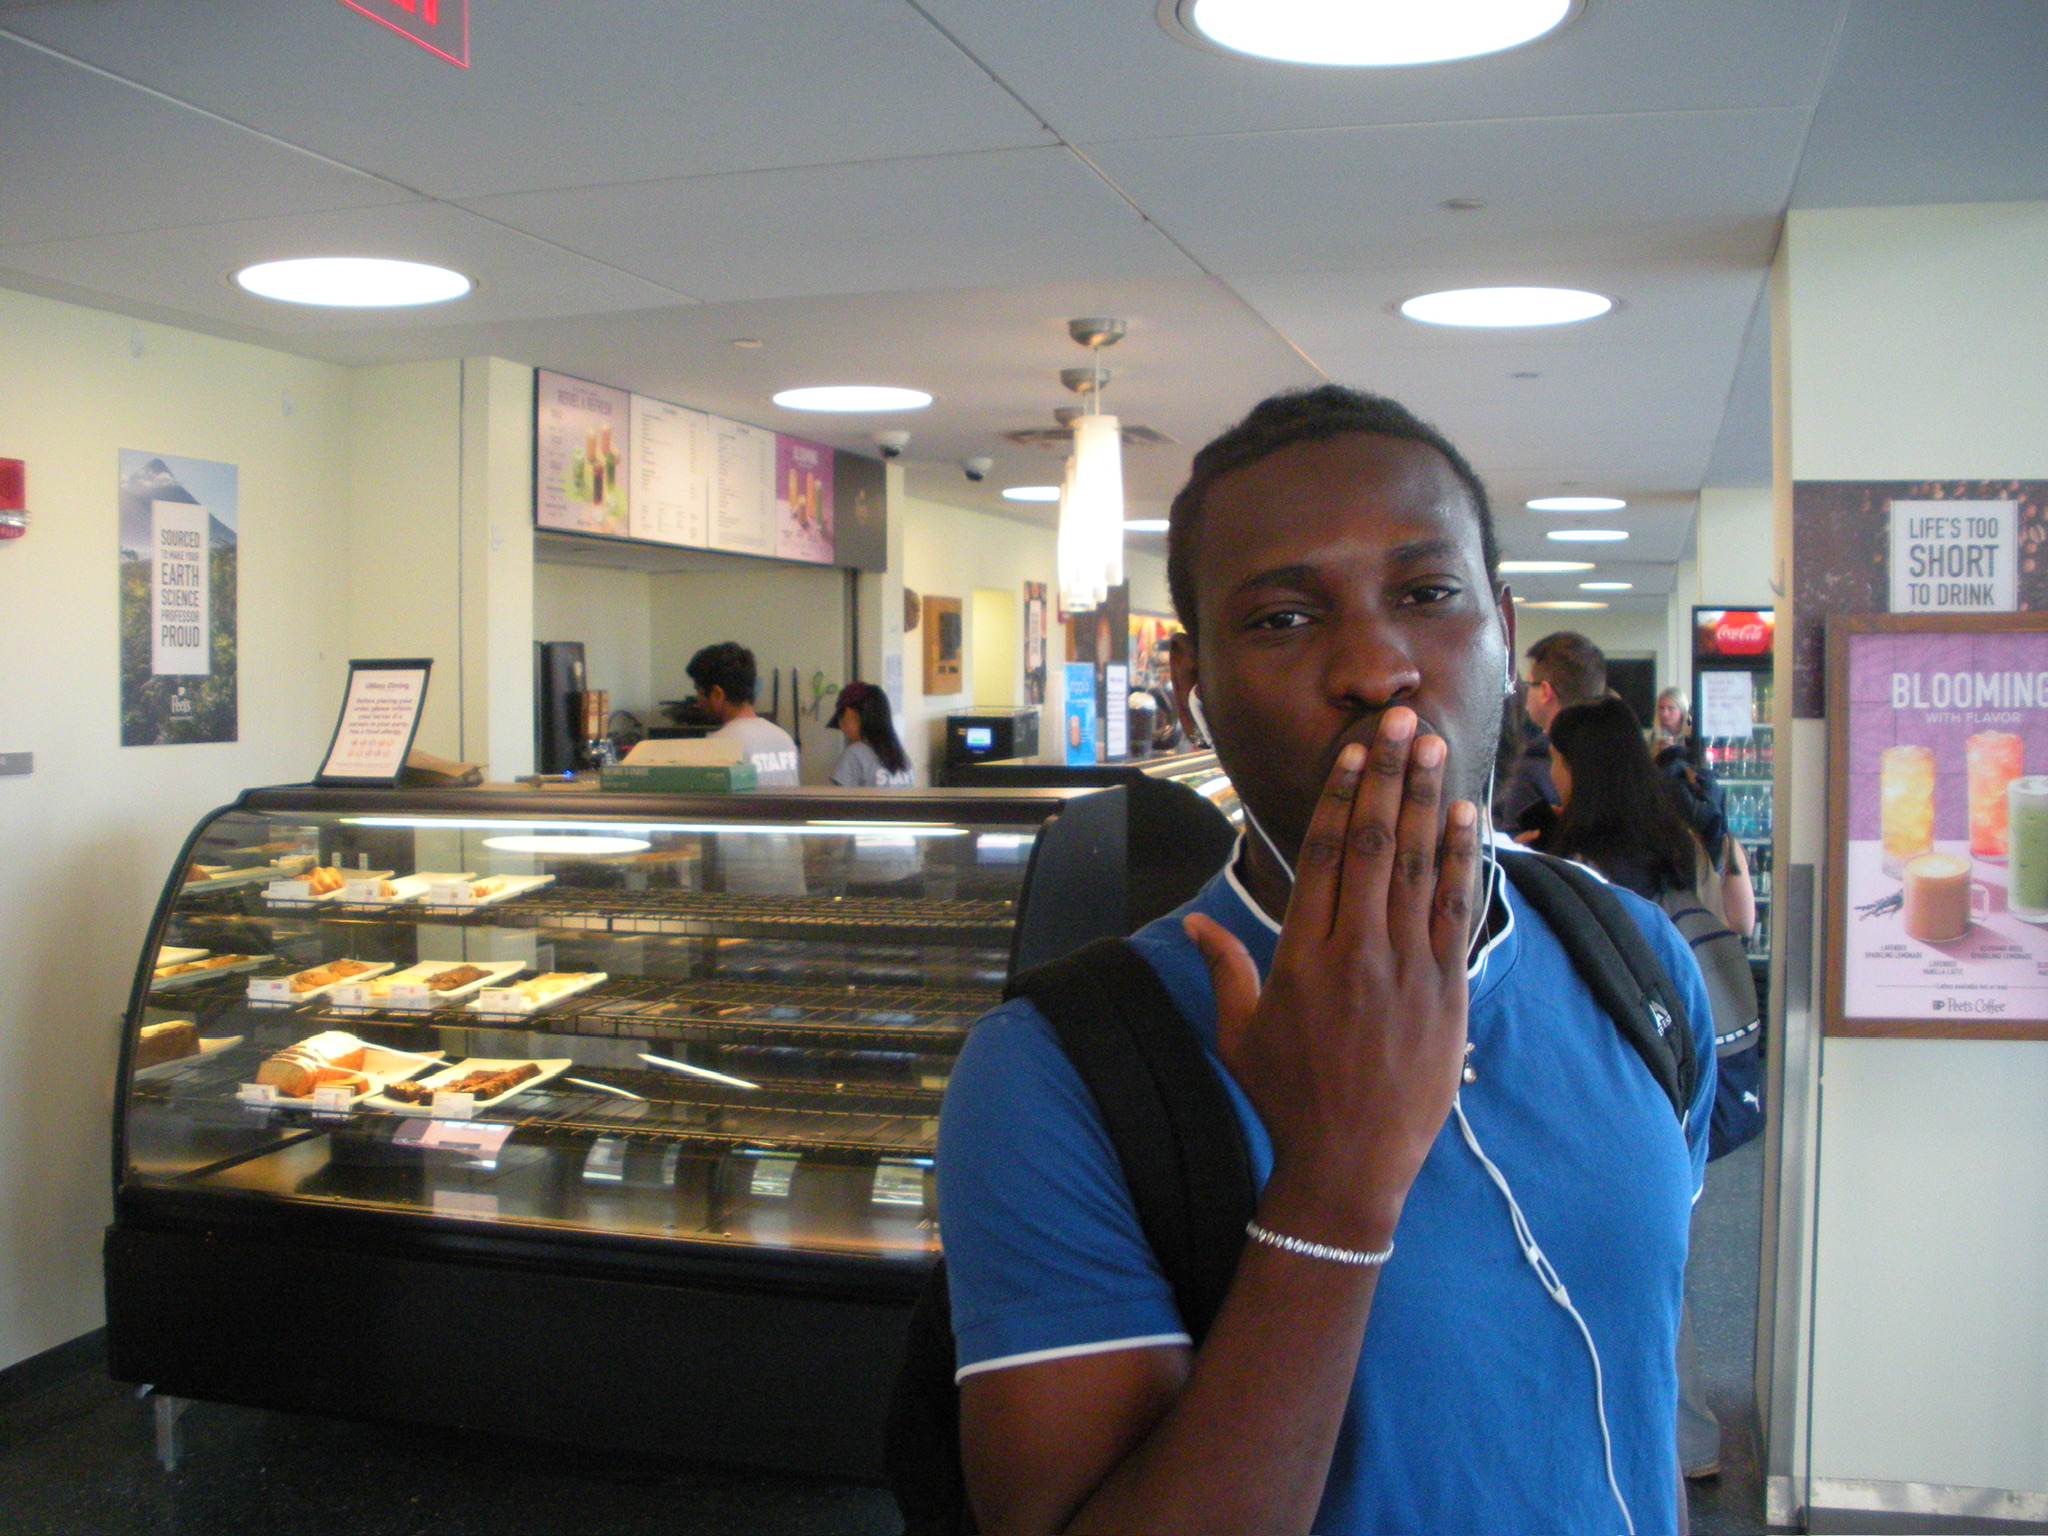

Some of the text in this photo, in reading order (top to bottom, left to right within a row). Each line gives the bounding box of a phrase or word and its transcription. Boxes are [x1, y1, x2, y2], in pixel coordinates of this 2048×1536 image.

[161, 528, 200, 548] SOURCED
[1909, 517, 1999, 539] LIFE'S TOO
[1909, 544, 2000, 578] SHORT
[161, 562, 199, 587] EARTH
[161, 588, 199, 607] SCIENCE
[1908, 583, 1995, 606] TO DRINK
[161, 609, 199, 623] PROFESSOR
[161, 625, 200, 648] PROUD
[1892, 672, 2048, 709] BLOOMING
[1927, 713, 2021, 723] WITH FLAVOR
[751, 751, 797, 774] STAFF
[1975, 998, 2006, 1014] Coffee
